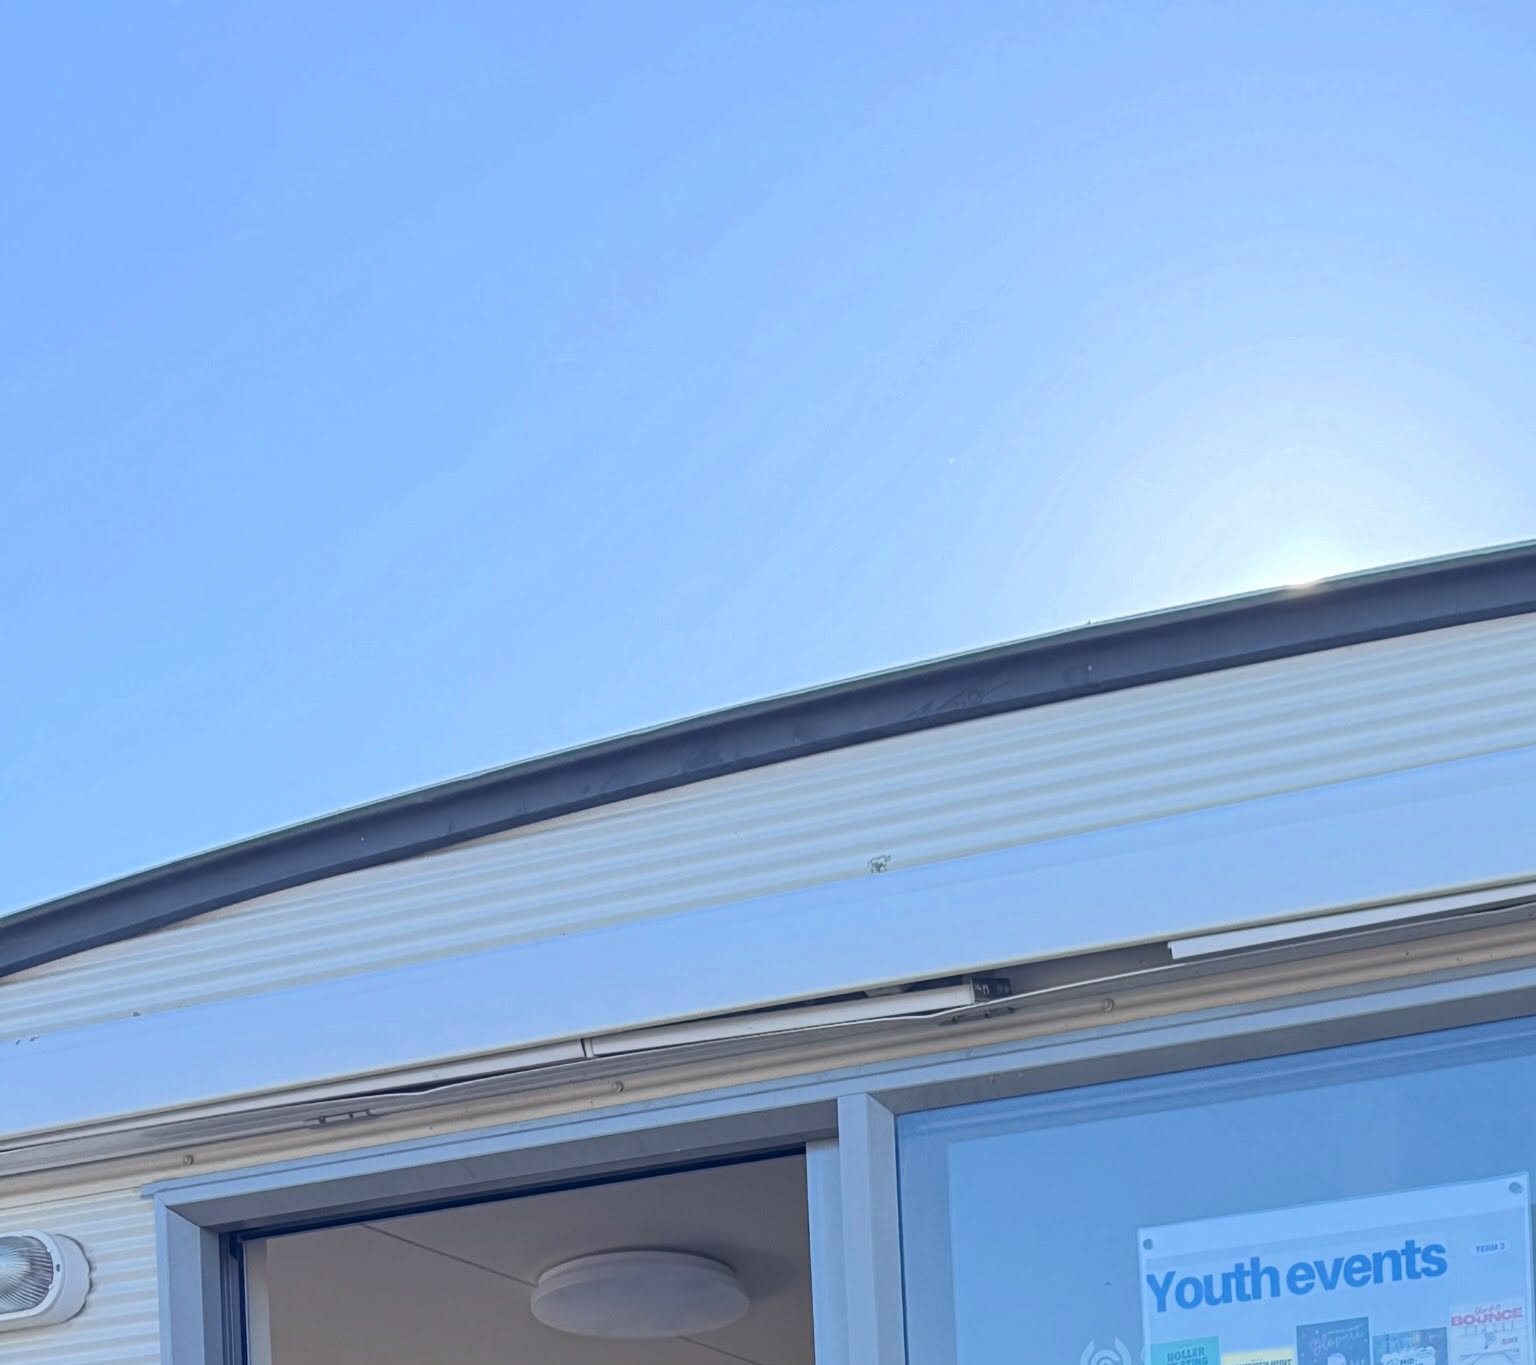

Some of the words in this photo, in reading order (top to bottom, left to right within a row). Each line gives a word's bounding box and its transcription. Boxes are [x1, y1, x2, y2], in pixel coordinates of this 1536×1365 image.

[1475, 1243, 1498, 1253] TERM
[1146, 1256, 1281, 1313] Youth
[1286, 1239, 1448, 1295] events
[1451, 1307, 1523, 1327] BOUNCE
[1167, 1347, 1205, 1362] ROLLER
